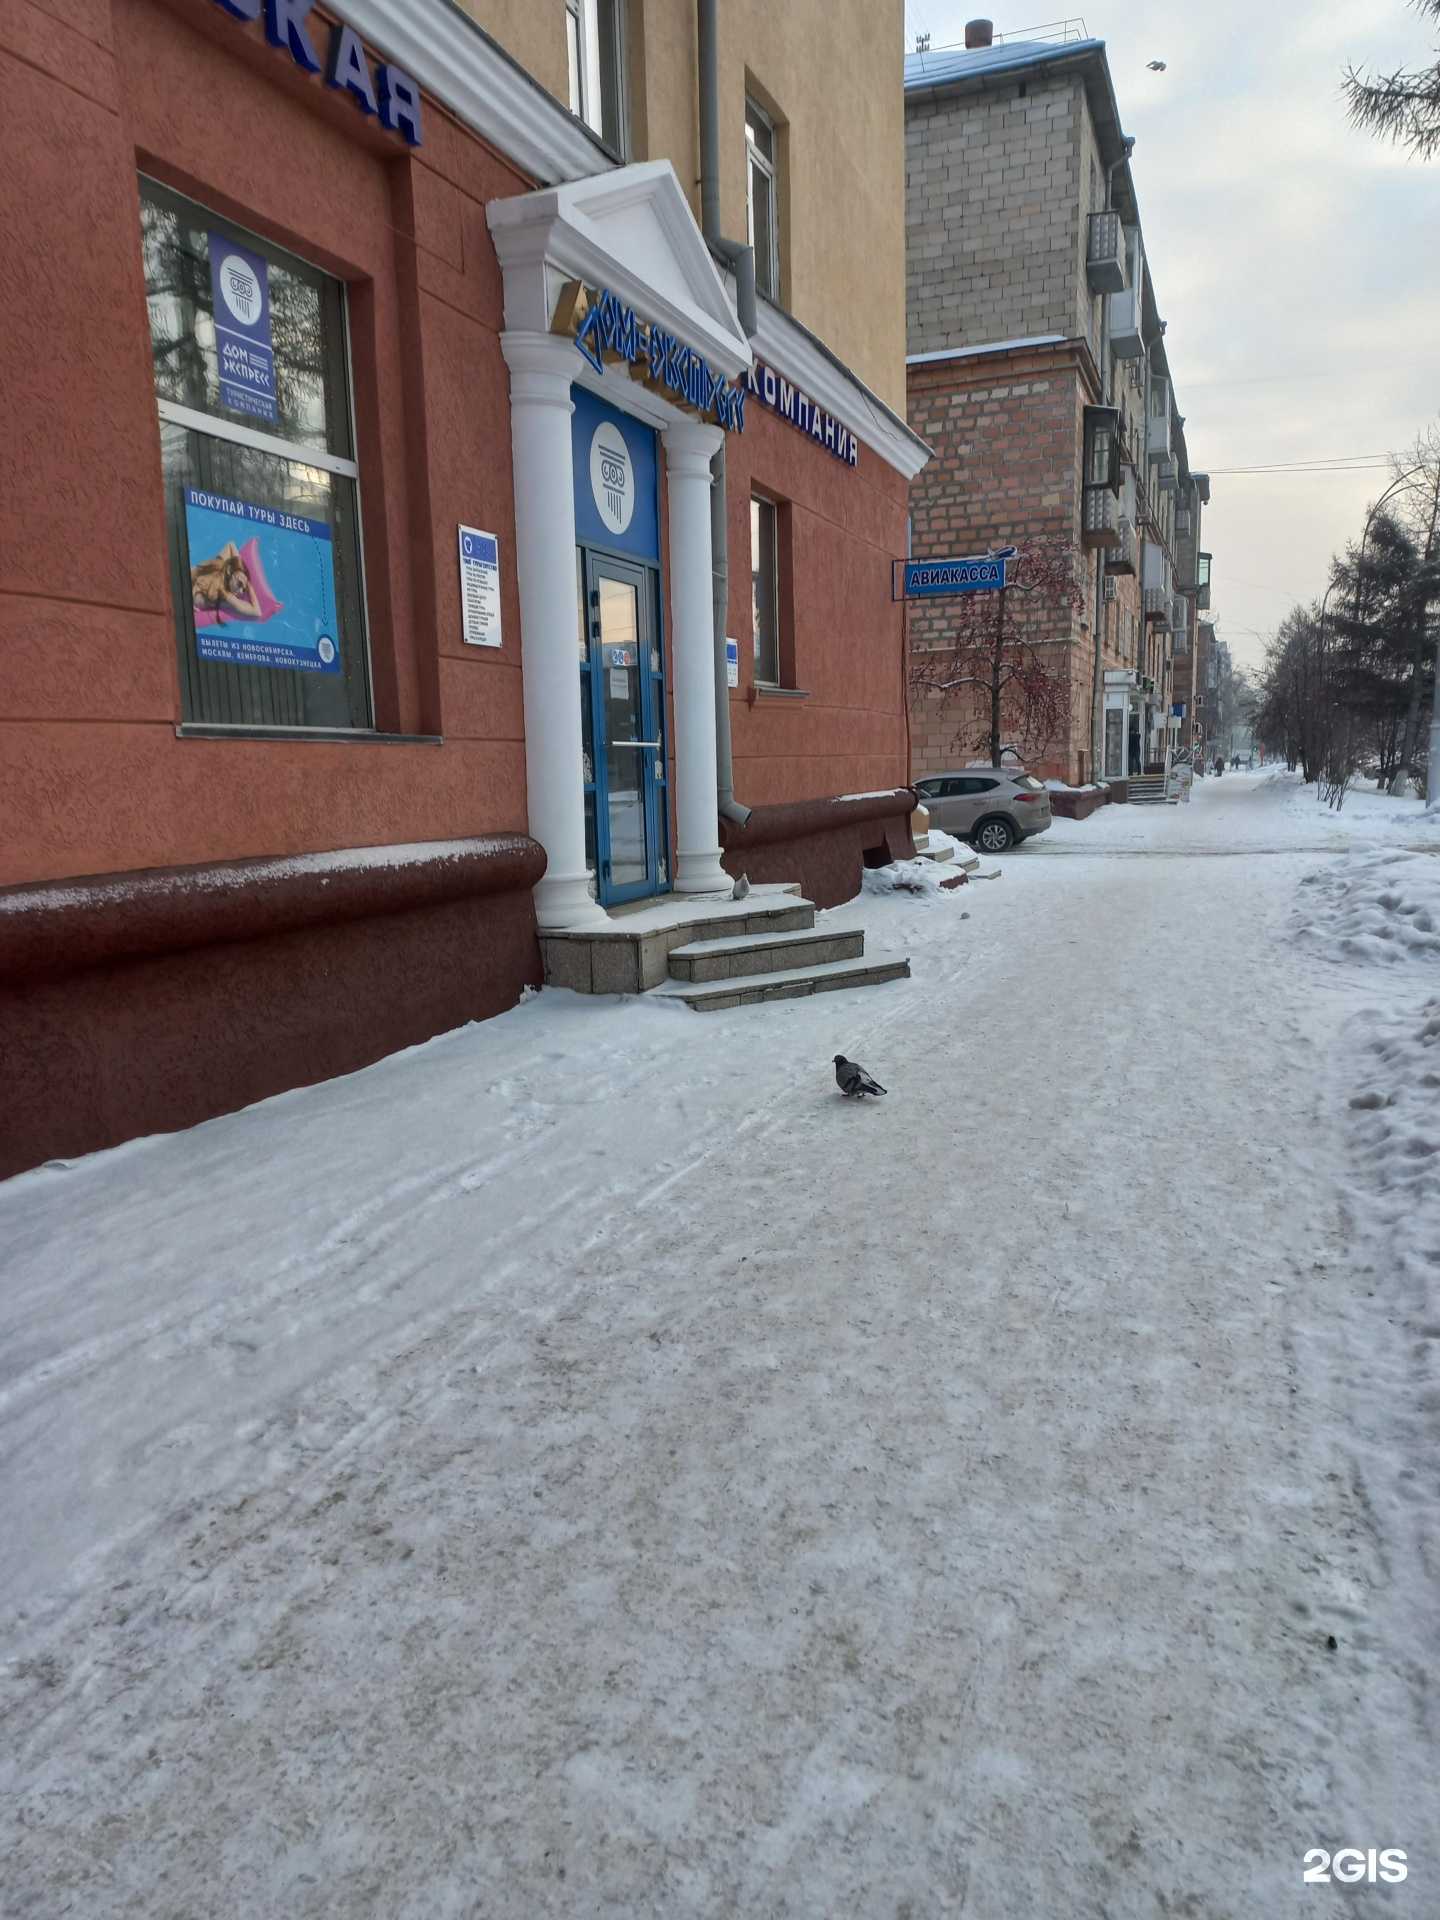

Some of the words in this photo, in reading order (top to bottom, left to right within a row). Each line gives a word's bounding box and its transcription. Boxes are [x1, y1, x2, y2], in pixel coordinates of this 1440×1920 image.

[213, 0, 423, 146] КАЯ
[223, 343, 248, 363] ДОМ
[223, 357, 270, 387] ЭКСПРЕСС
[747, 358, 858, 466] КОМПАНИЯ
[191, 490, 245, 516] ПОКУПАЙ
[249, 505, 276, 525] ТУРЫ
[279, 514, 310, 533] ЗДЕСЬ
[910, 563, 999, 587] АВИАКАССА
[201, 638, 228, 649] ВЫЛЕТЫ
[231, 642, 240, 650] ИЗ
